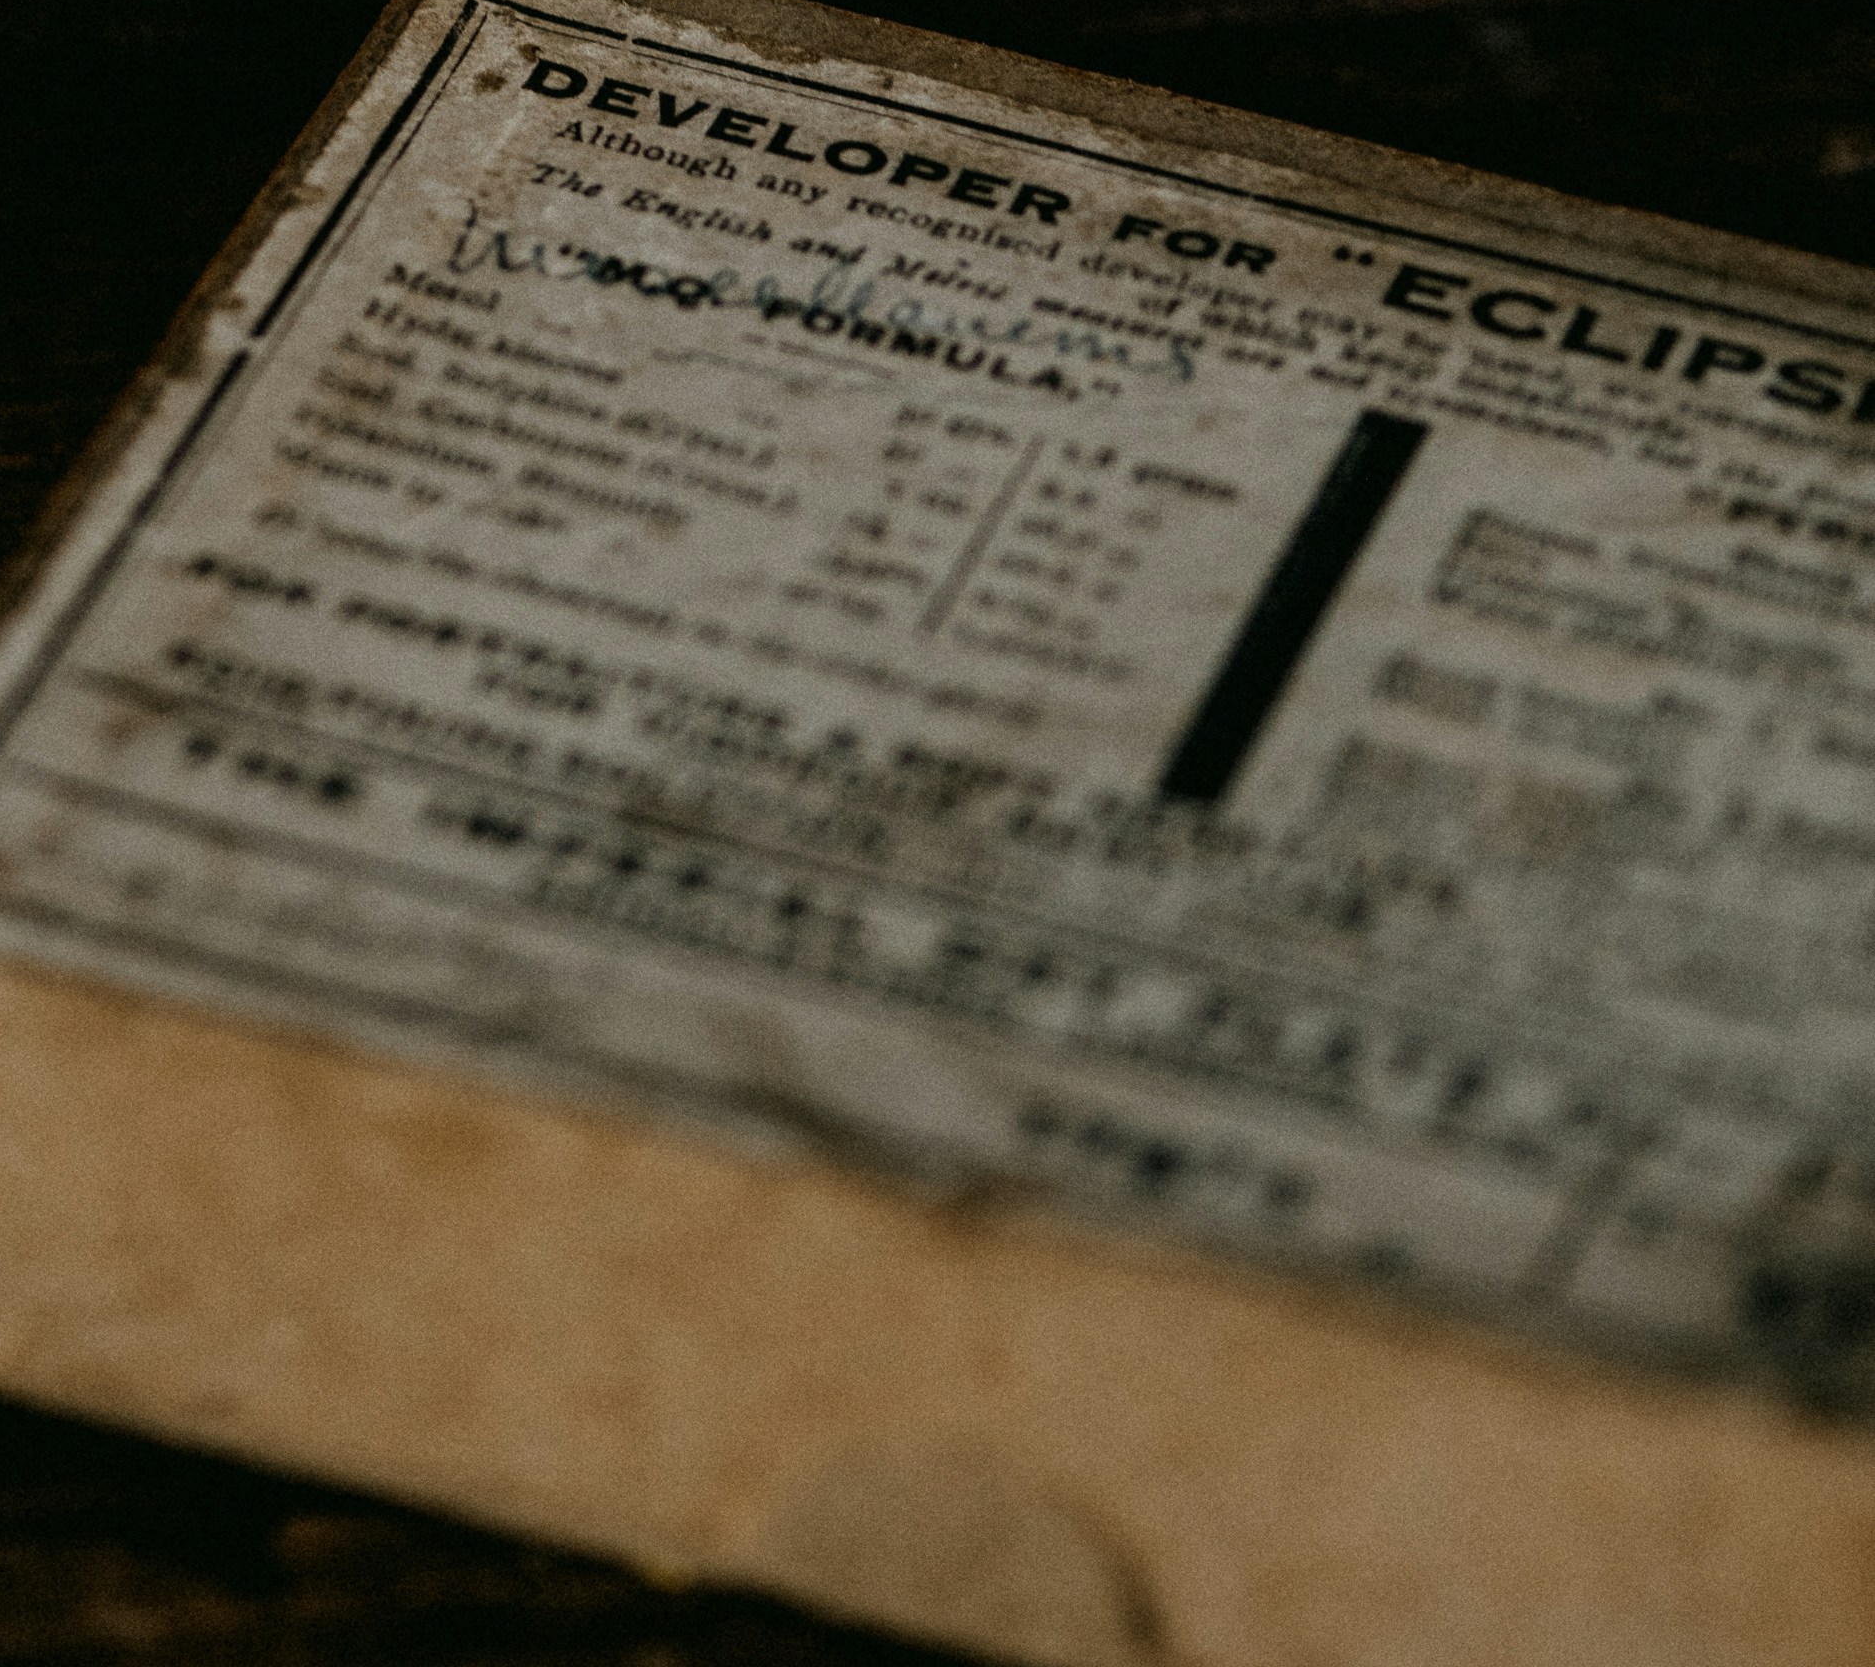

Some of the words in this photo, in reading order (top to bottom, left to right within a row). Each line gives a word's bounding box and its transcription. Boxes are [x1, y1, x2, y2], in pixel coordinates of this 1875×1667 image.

[521, 58, 1074, 227] DEVELOPER
[1112, 212, 1279, 275] FOR
[529, 162, 606, 200] The
[621, 185, 775, 244] English
[789, 230, 868, 268] and
[554, 118, 740, 184] Although
[754, 171, 829, 207] any
[846, 191, 1065, 265] recognised
[1078, 252, 1279, 316] developer
